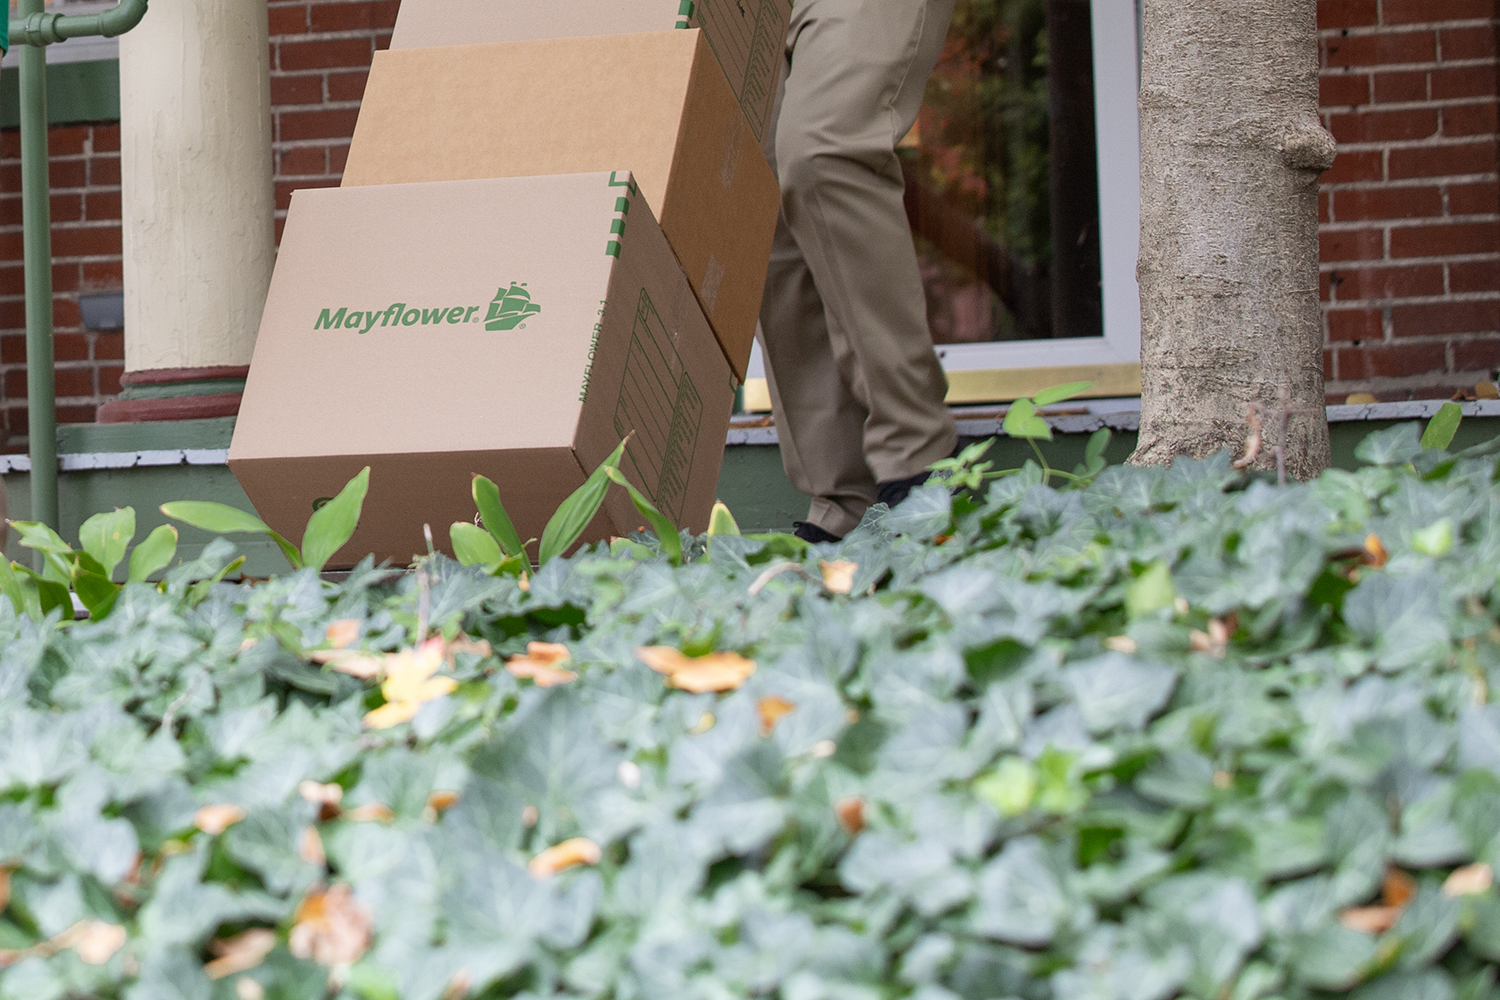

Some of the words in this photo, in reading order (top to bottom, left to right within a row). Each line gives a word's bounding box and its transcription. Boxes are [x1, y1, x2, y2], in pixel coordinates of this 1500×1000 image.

[313, 302, 480, 335] Mayflower
[578, 322, 603, 403] MAYFLOWER
[597, 299, 608, 317] 3.1
